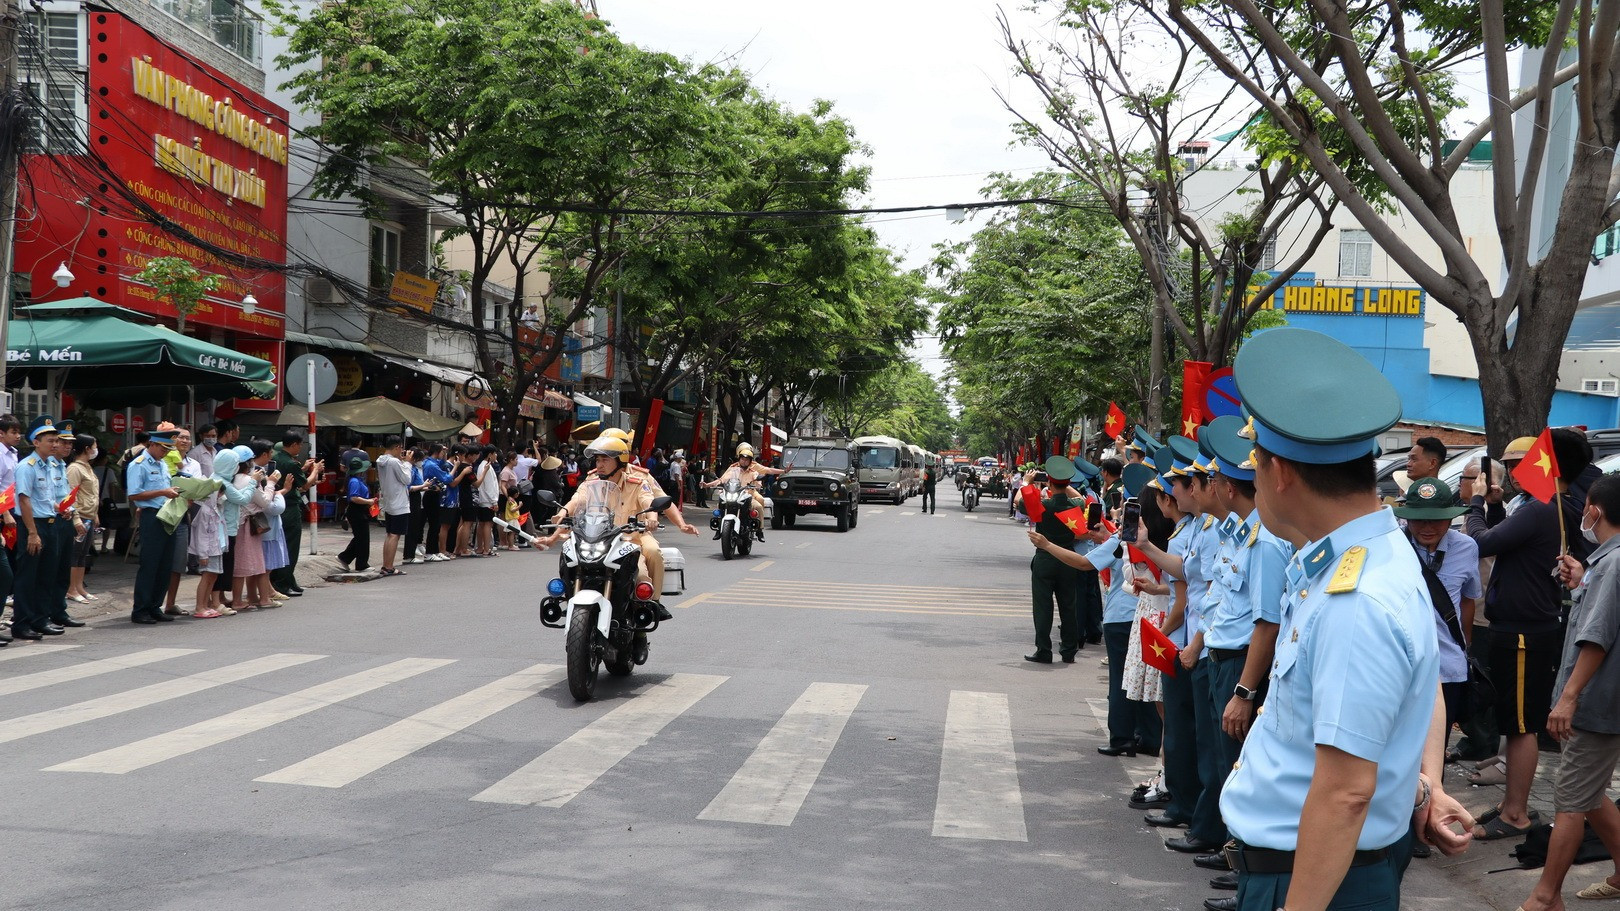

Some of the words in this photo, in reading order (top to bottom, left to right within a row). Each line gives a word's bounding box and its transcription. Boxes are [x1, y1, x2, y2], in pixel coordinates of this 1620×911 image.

[131, 54, 165, 107] VĂN
[214, 97, 250, 148] CÔNG
[134, 180, 154, 199] CÔNG
[154, 189, 178, 208] CHỨNG
[178, 196, 191, 213] CÁC
[232, 167, 266, 208] XUÂN
[133, 227, 154, 246] CÔNG
[133, 252, 153, 269] CÔN
[1363, 287, 1421, 314] LONG
[6, 348, 31, 361] Bé
[39, 346, 82, 361] Mến
[217, 357, 229, 371] Bé
[229, 359, 246, 374] Mến
[618, 543, 636, 557] CSGT
